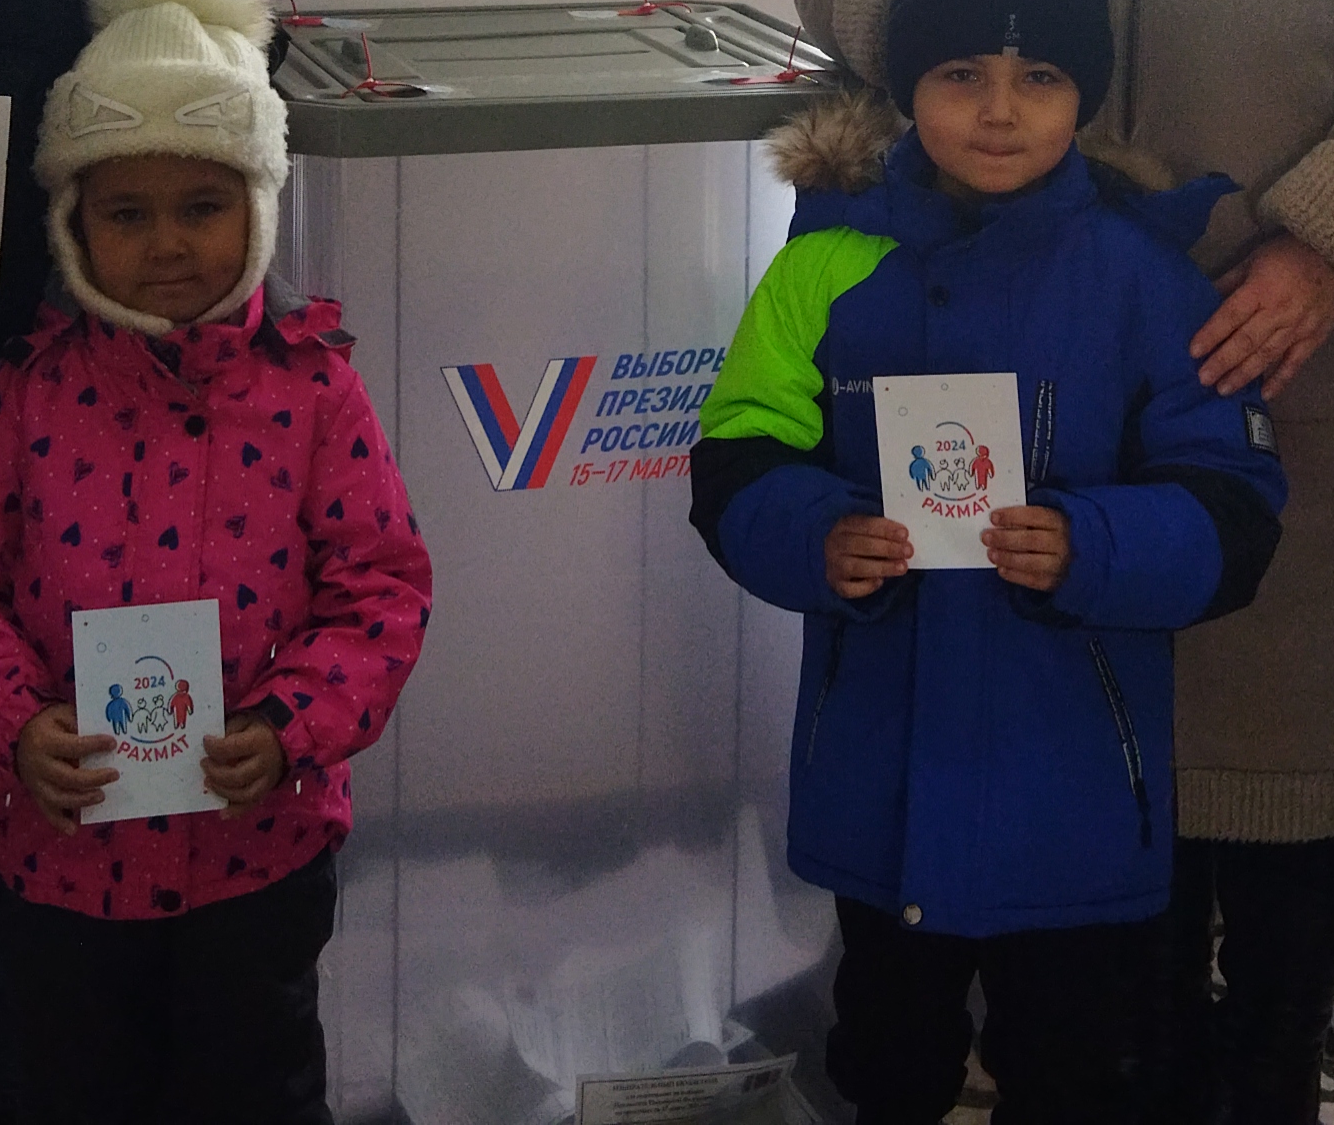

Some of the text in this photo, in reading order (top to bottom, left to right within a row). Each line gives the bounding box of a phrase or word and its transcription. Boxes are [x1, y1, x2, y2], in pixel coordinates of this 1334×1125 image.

[581, 420, 700, 455] РОССИИ
[935, 439, 967, 453] 2024
[921, 495, 992, 519] РАХМАТ
[134, 676, 166, 690] 2024
[117, 734, 191, 763] РАХМАТ
